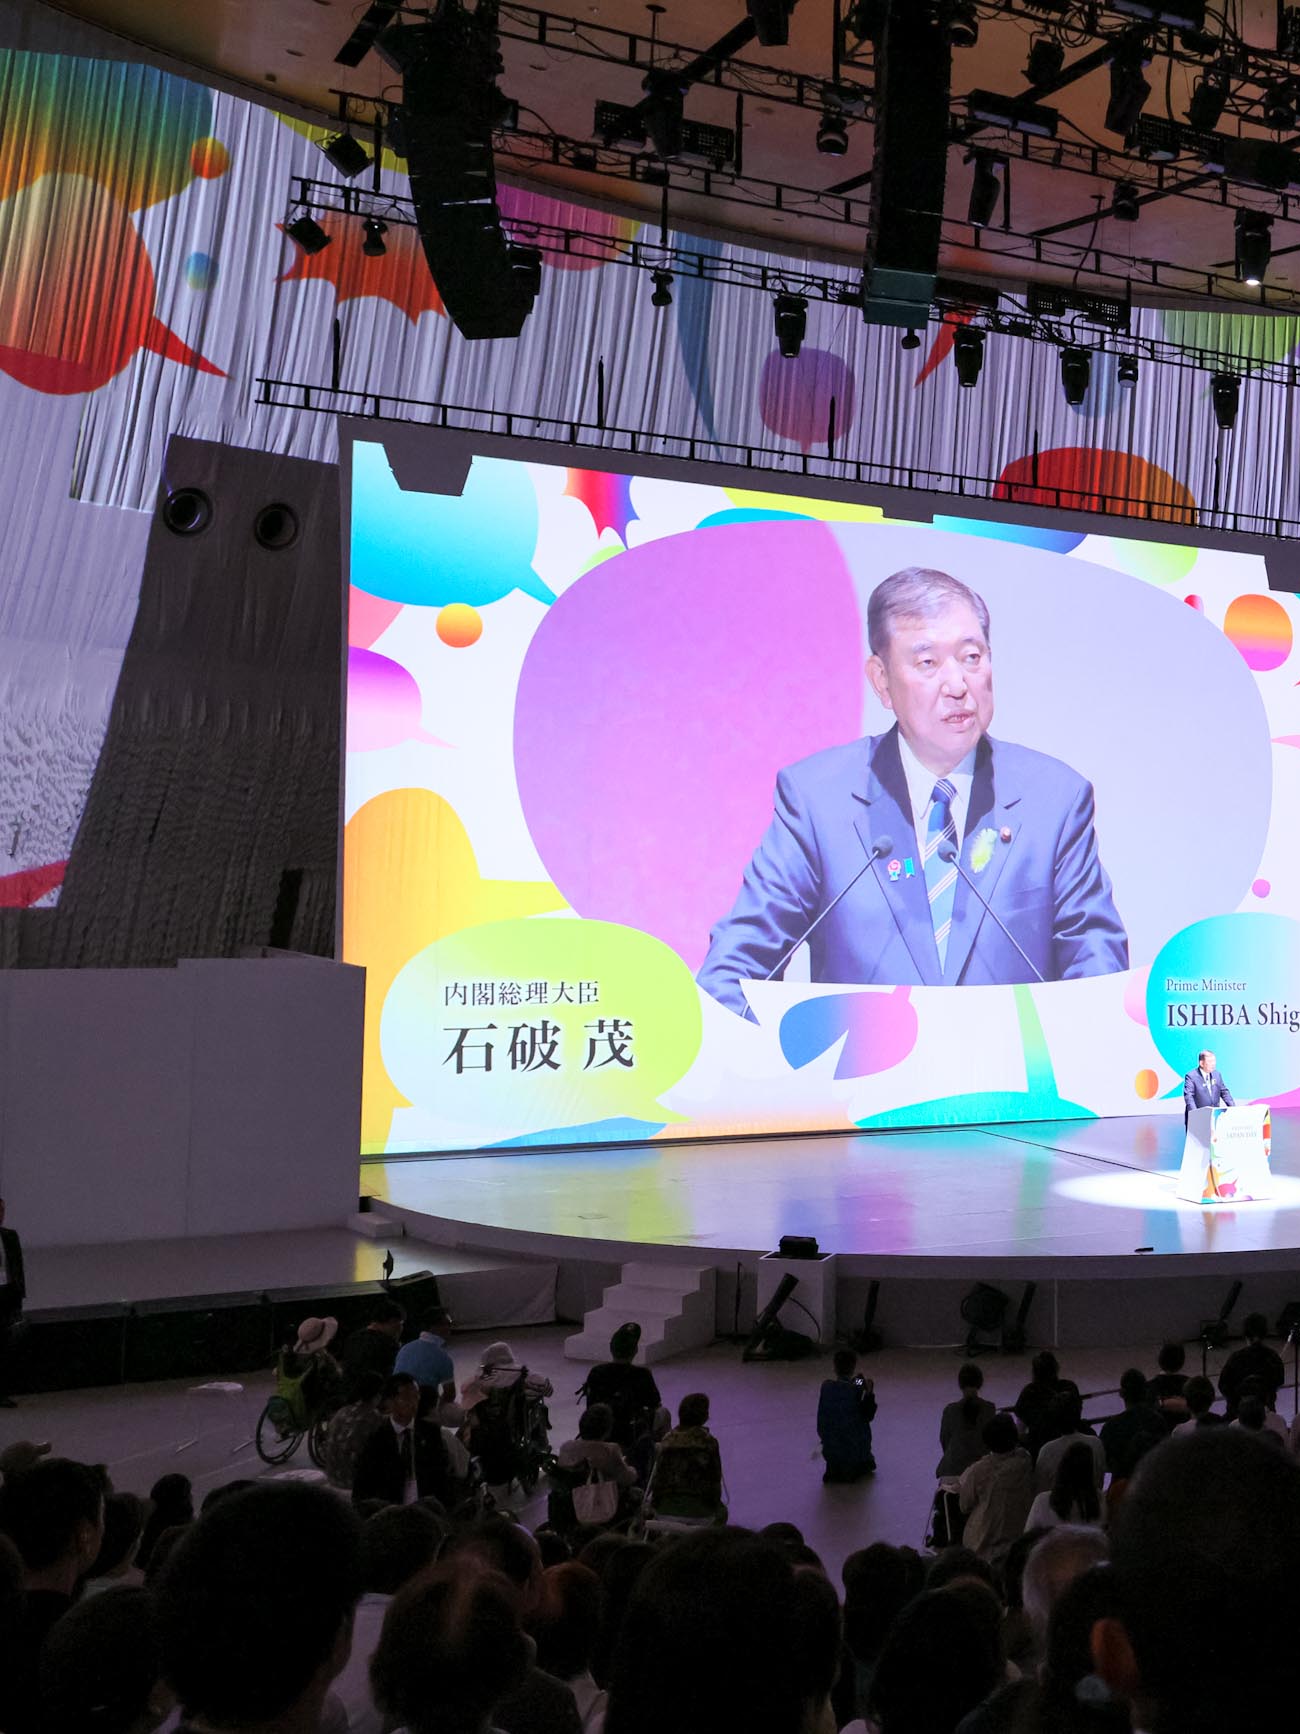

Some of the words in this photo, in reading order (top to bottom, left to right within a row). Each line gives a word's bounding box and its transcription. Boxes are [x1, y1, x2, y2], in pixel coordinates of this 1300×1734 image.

[444, 980, 600, 1006] 内閣総理大臣
[1166, 978, 1199, 992] Prime
[1201, 978, 1247, 991] Minister
[1167, 1004, 1251, 1027] ISHIBA
